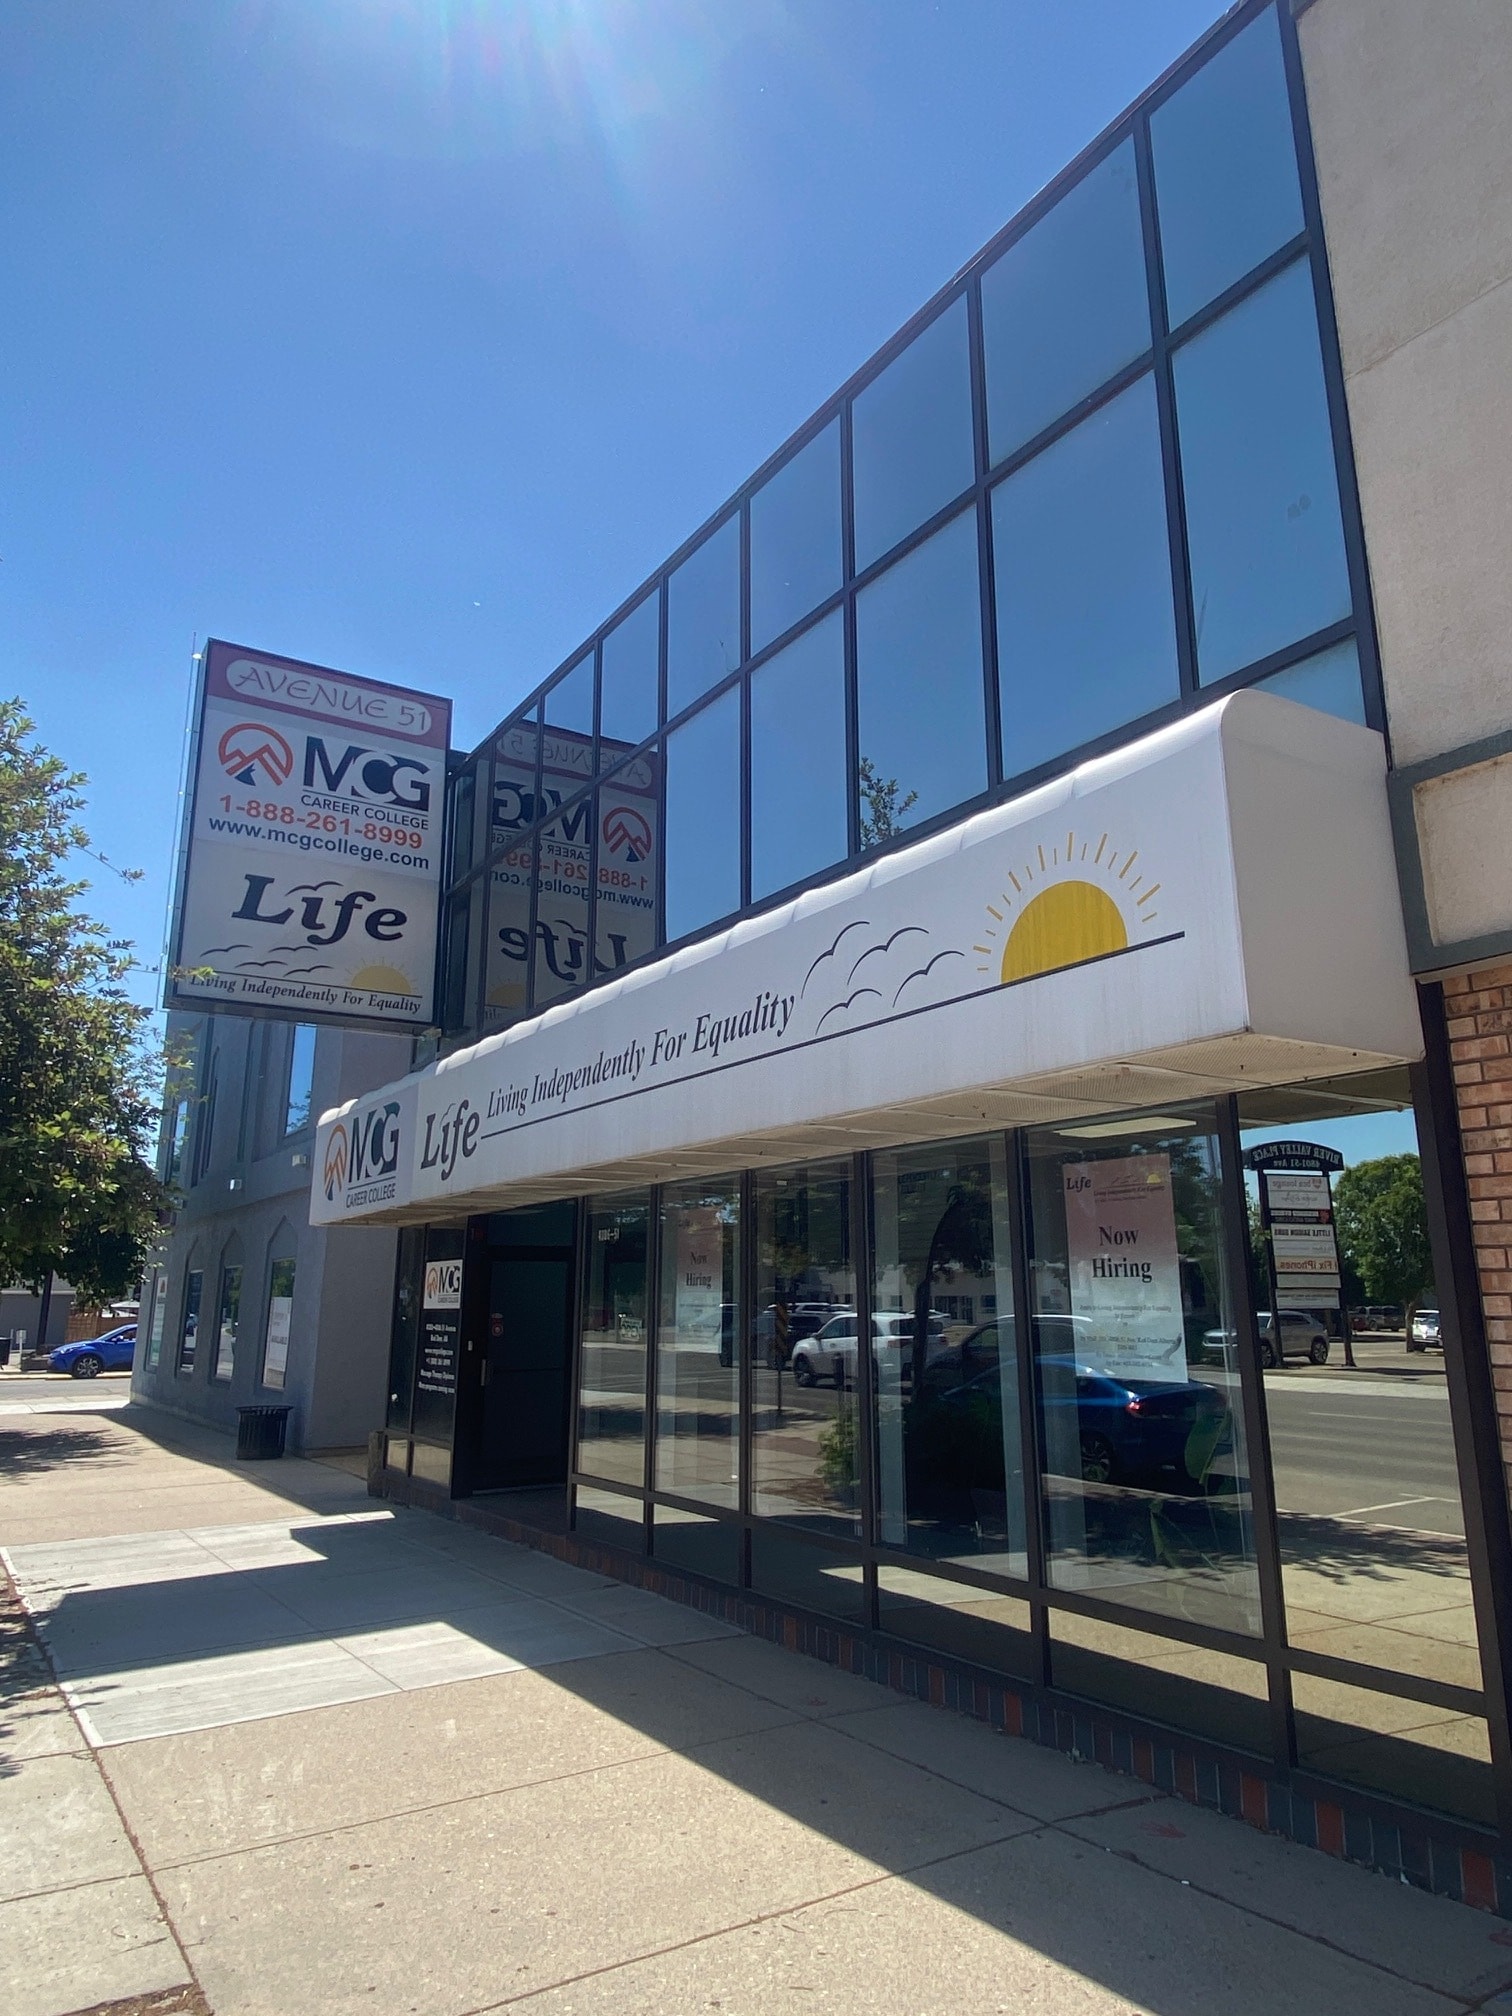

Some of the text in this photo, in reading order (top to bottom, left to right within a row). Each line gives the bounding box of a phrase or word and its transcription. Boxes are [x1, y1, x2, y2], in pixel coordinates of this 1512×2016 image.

[234, 666, 428, 731] AVENUE 51
[302, 735, 431, 812] MCG
[219, 794, 424, 850] 1-888-261-8999
[301, 794, 430, 831] CAREER COLLEGE
[208, 817, 430, 870] www.mcgcollege.com
[231, 873, 408, 946] Life
[241, 978, 338, 1006] Independently
[342, 991, 365, 1007] For
[367, 993, 421, 1014] Equality
[486, 991, 795, 1118] Living Independently For Equality
[348, 1101, 401, 1183] MCG
[420, 1099, 480, 1181] Life
[345, 1183, 397, 1209] CAREER COLLEGE
[1066, 1176, 1092, 1193] Life
[1099, 1226, 1139, 1247] Now
[438, 1265, 461, 1293] MCG
[686, 1272, 712, 1289] Hiring
[1092, 1257, 1152, 1284] Hiring
